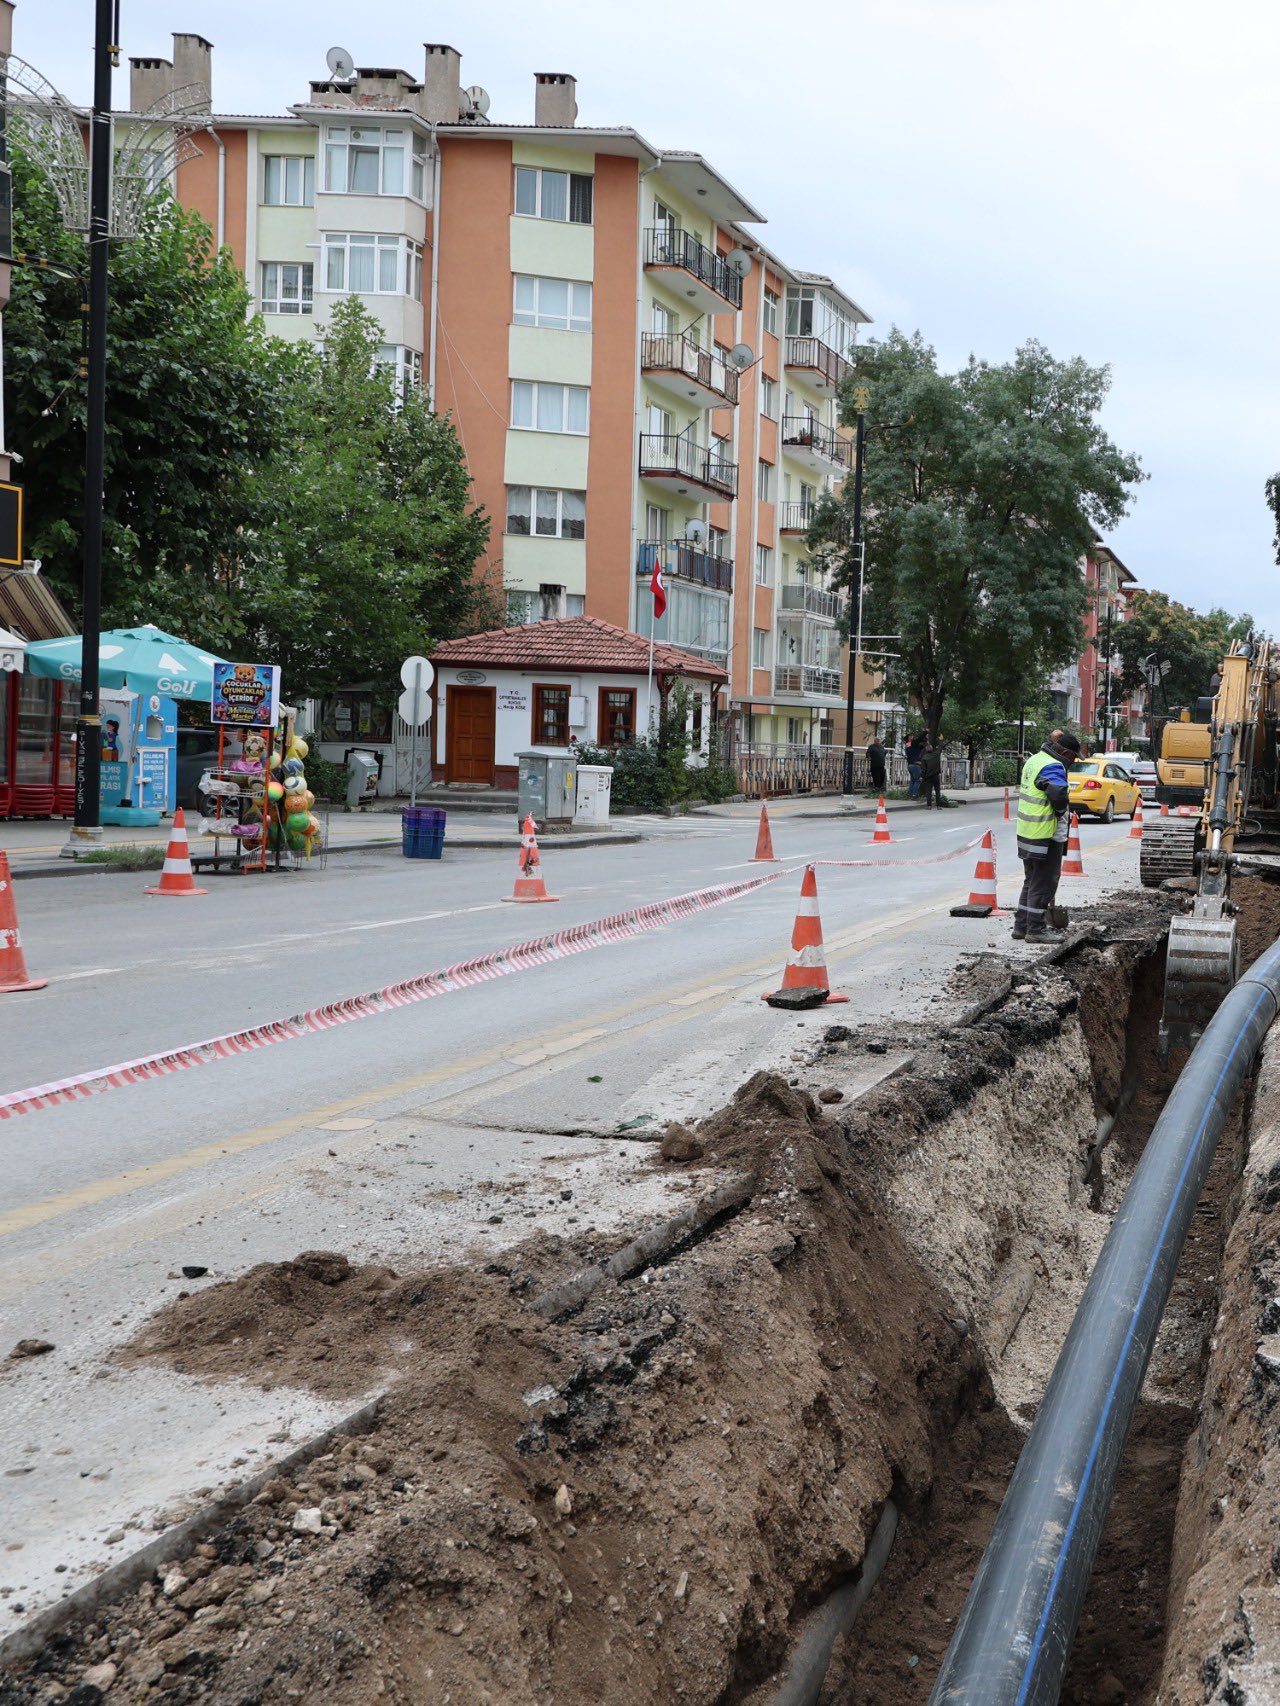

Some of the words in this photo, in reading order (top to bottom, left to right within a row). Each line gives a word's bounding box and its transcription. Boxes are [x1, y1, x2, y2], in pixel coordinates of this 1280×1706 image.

[60, 662, 82, 679] Go
[157, 676, 198, 695] Golf
[223, 687, 264, 696] OYUNCAKLAR
